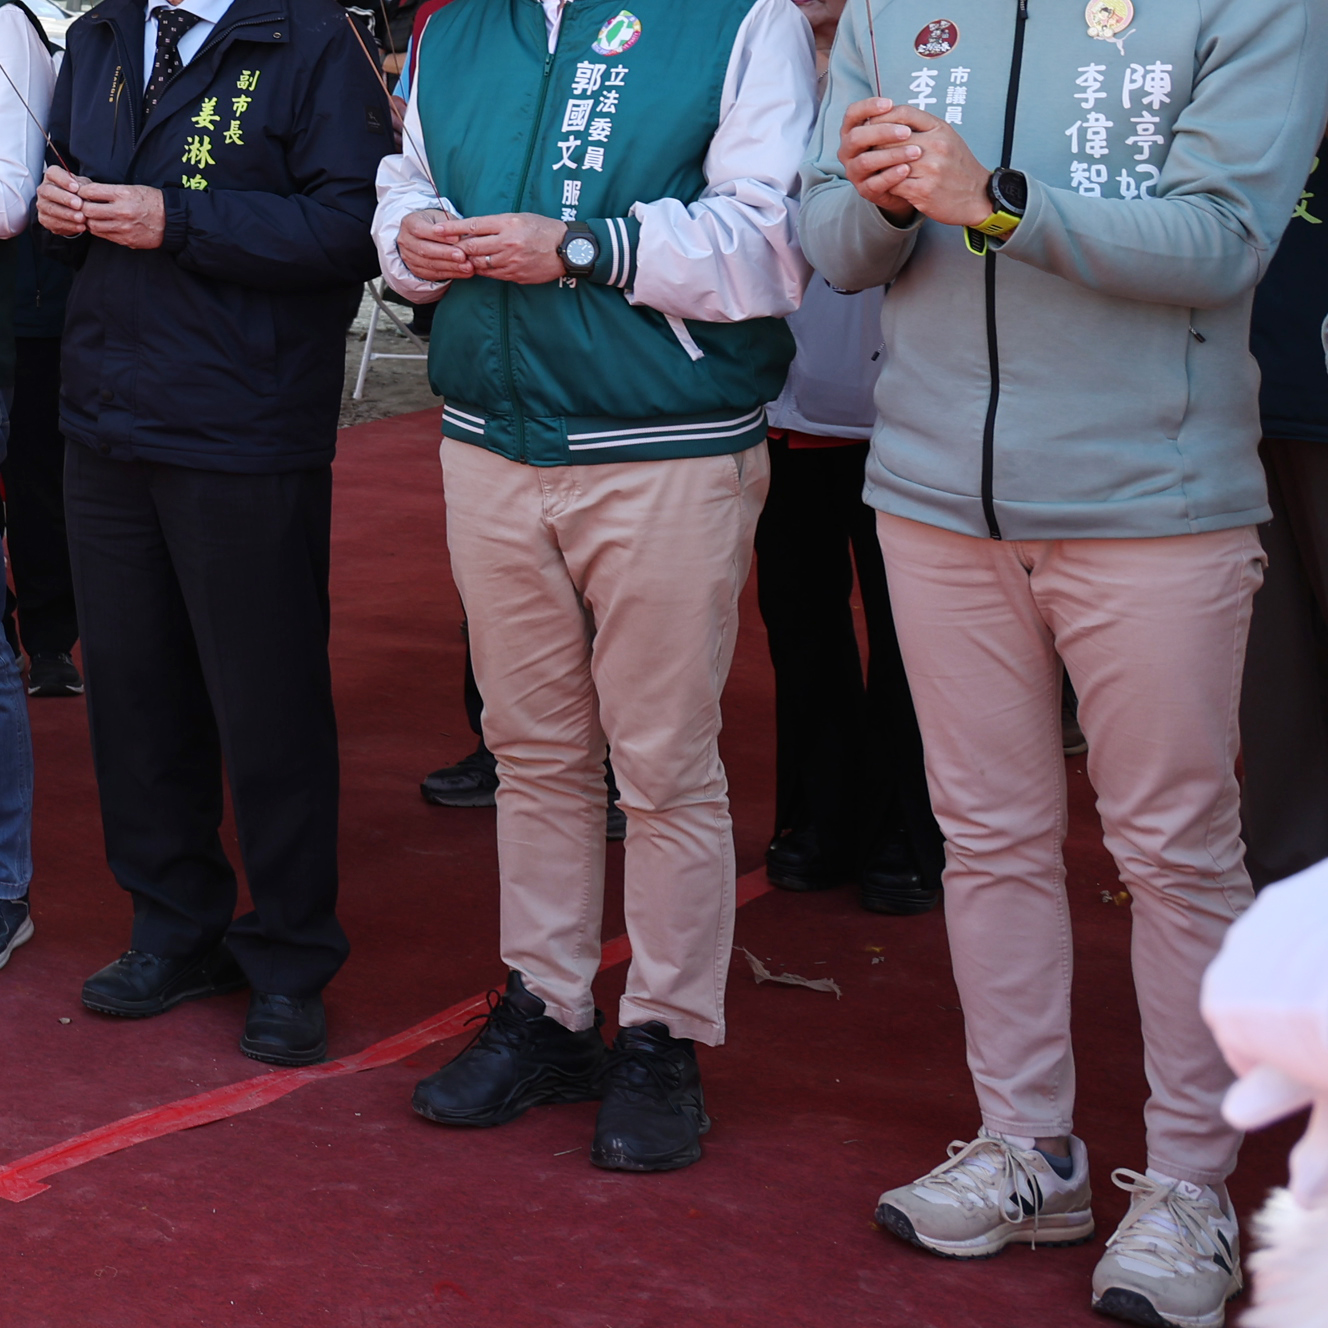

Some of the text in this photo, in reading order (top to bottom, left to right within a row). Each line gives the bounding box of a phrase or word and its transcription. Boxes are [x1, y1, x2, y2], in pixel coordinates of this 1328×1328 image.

[222, 69, 261, 146] 副市長
[552, 60, 607, 171] 郭國文
[581, 64, 629, 173] 立法委員
[944, 66, 971, 125] 市議員
[1065, 62, 1114, 199] 李偉智
[1115, 60, 1173, 201] 陳亭妃
